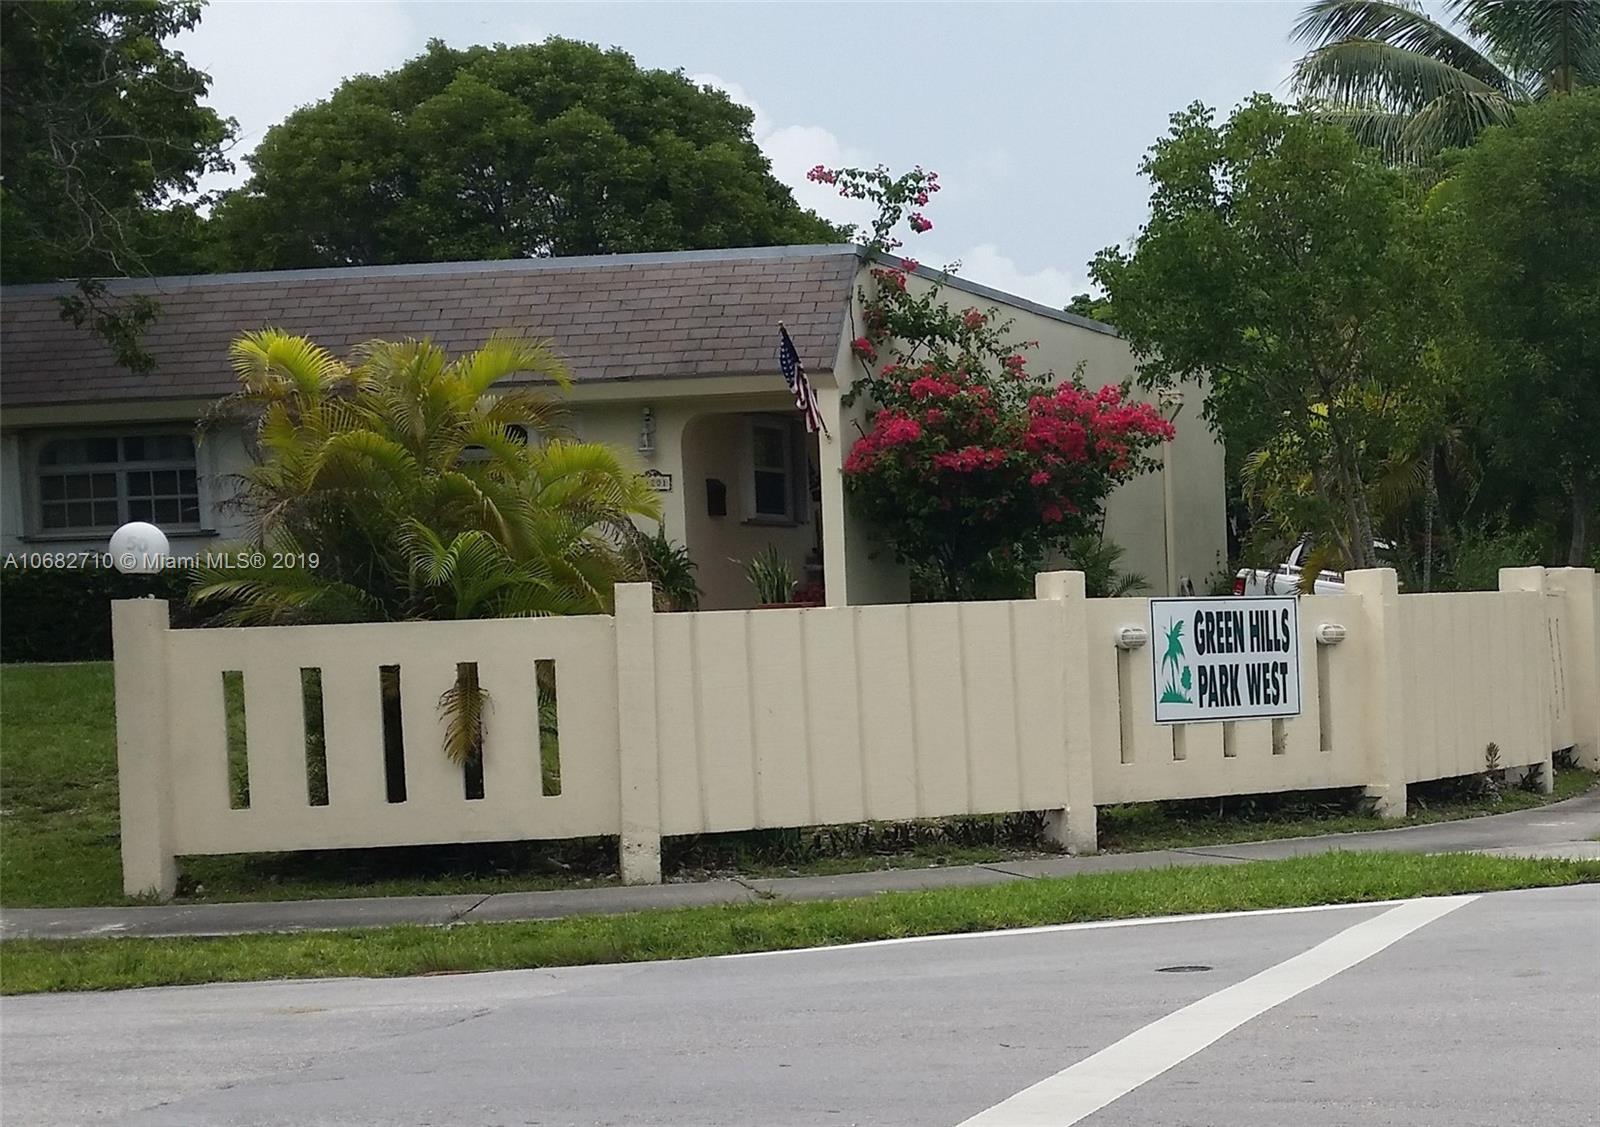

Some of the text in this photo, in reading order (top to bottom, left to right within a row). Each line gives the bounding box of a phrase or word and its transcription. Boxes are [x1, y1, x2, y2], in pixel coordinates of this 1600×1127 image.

[1194, 608, 1290, 656] GREEN HILLS
[1197, 661, 1289, 708] PARK WEST
